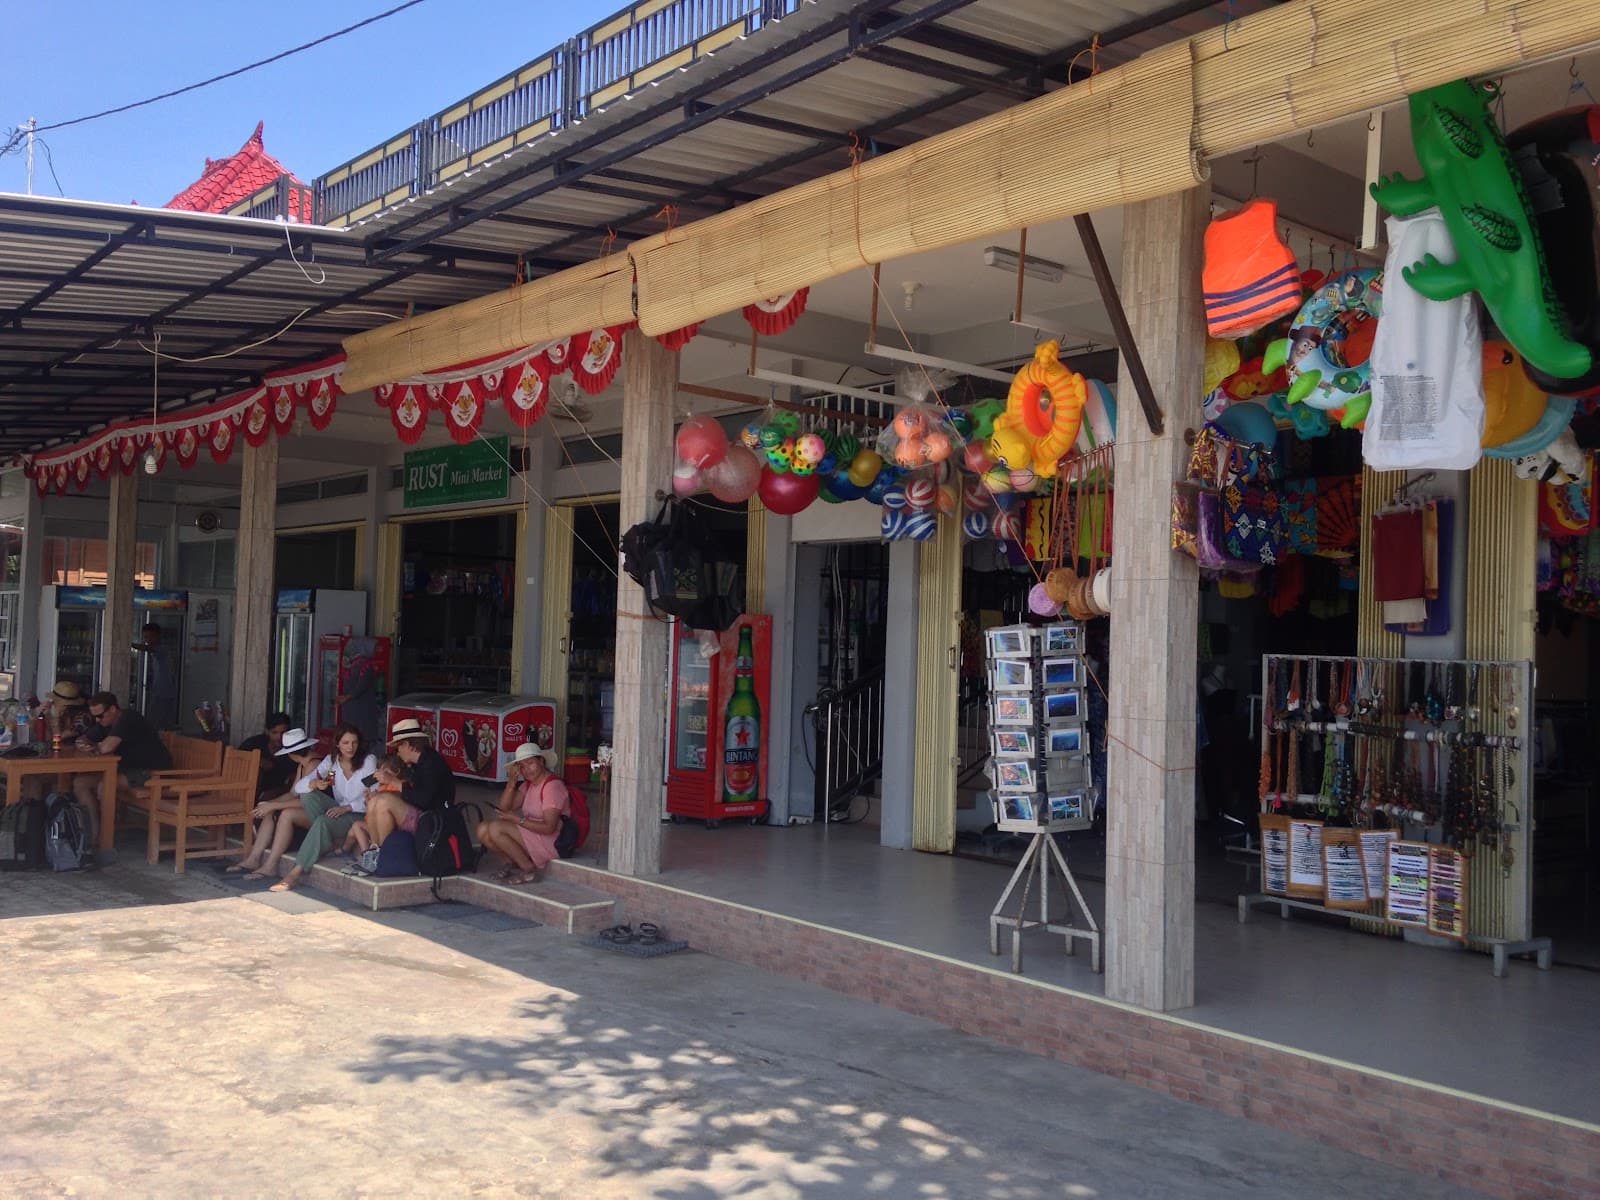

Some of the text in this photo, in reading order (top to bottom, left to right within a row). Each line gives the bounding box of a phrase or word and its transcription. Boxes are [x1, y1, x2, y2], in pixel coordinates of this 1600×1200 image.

[408, 462, 502, 491] RUST Mini Market
